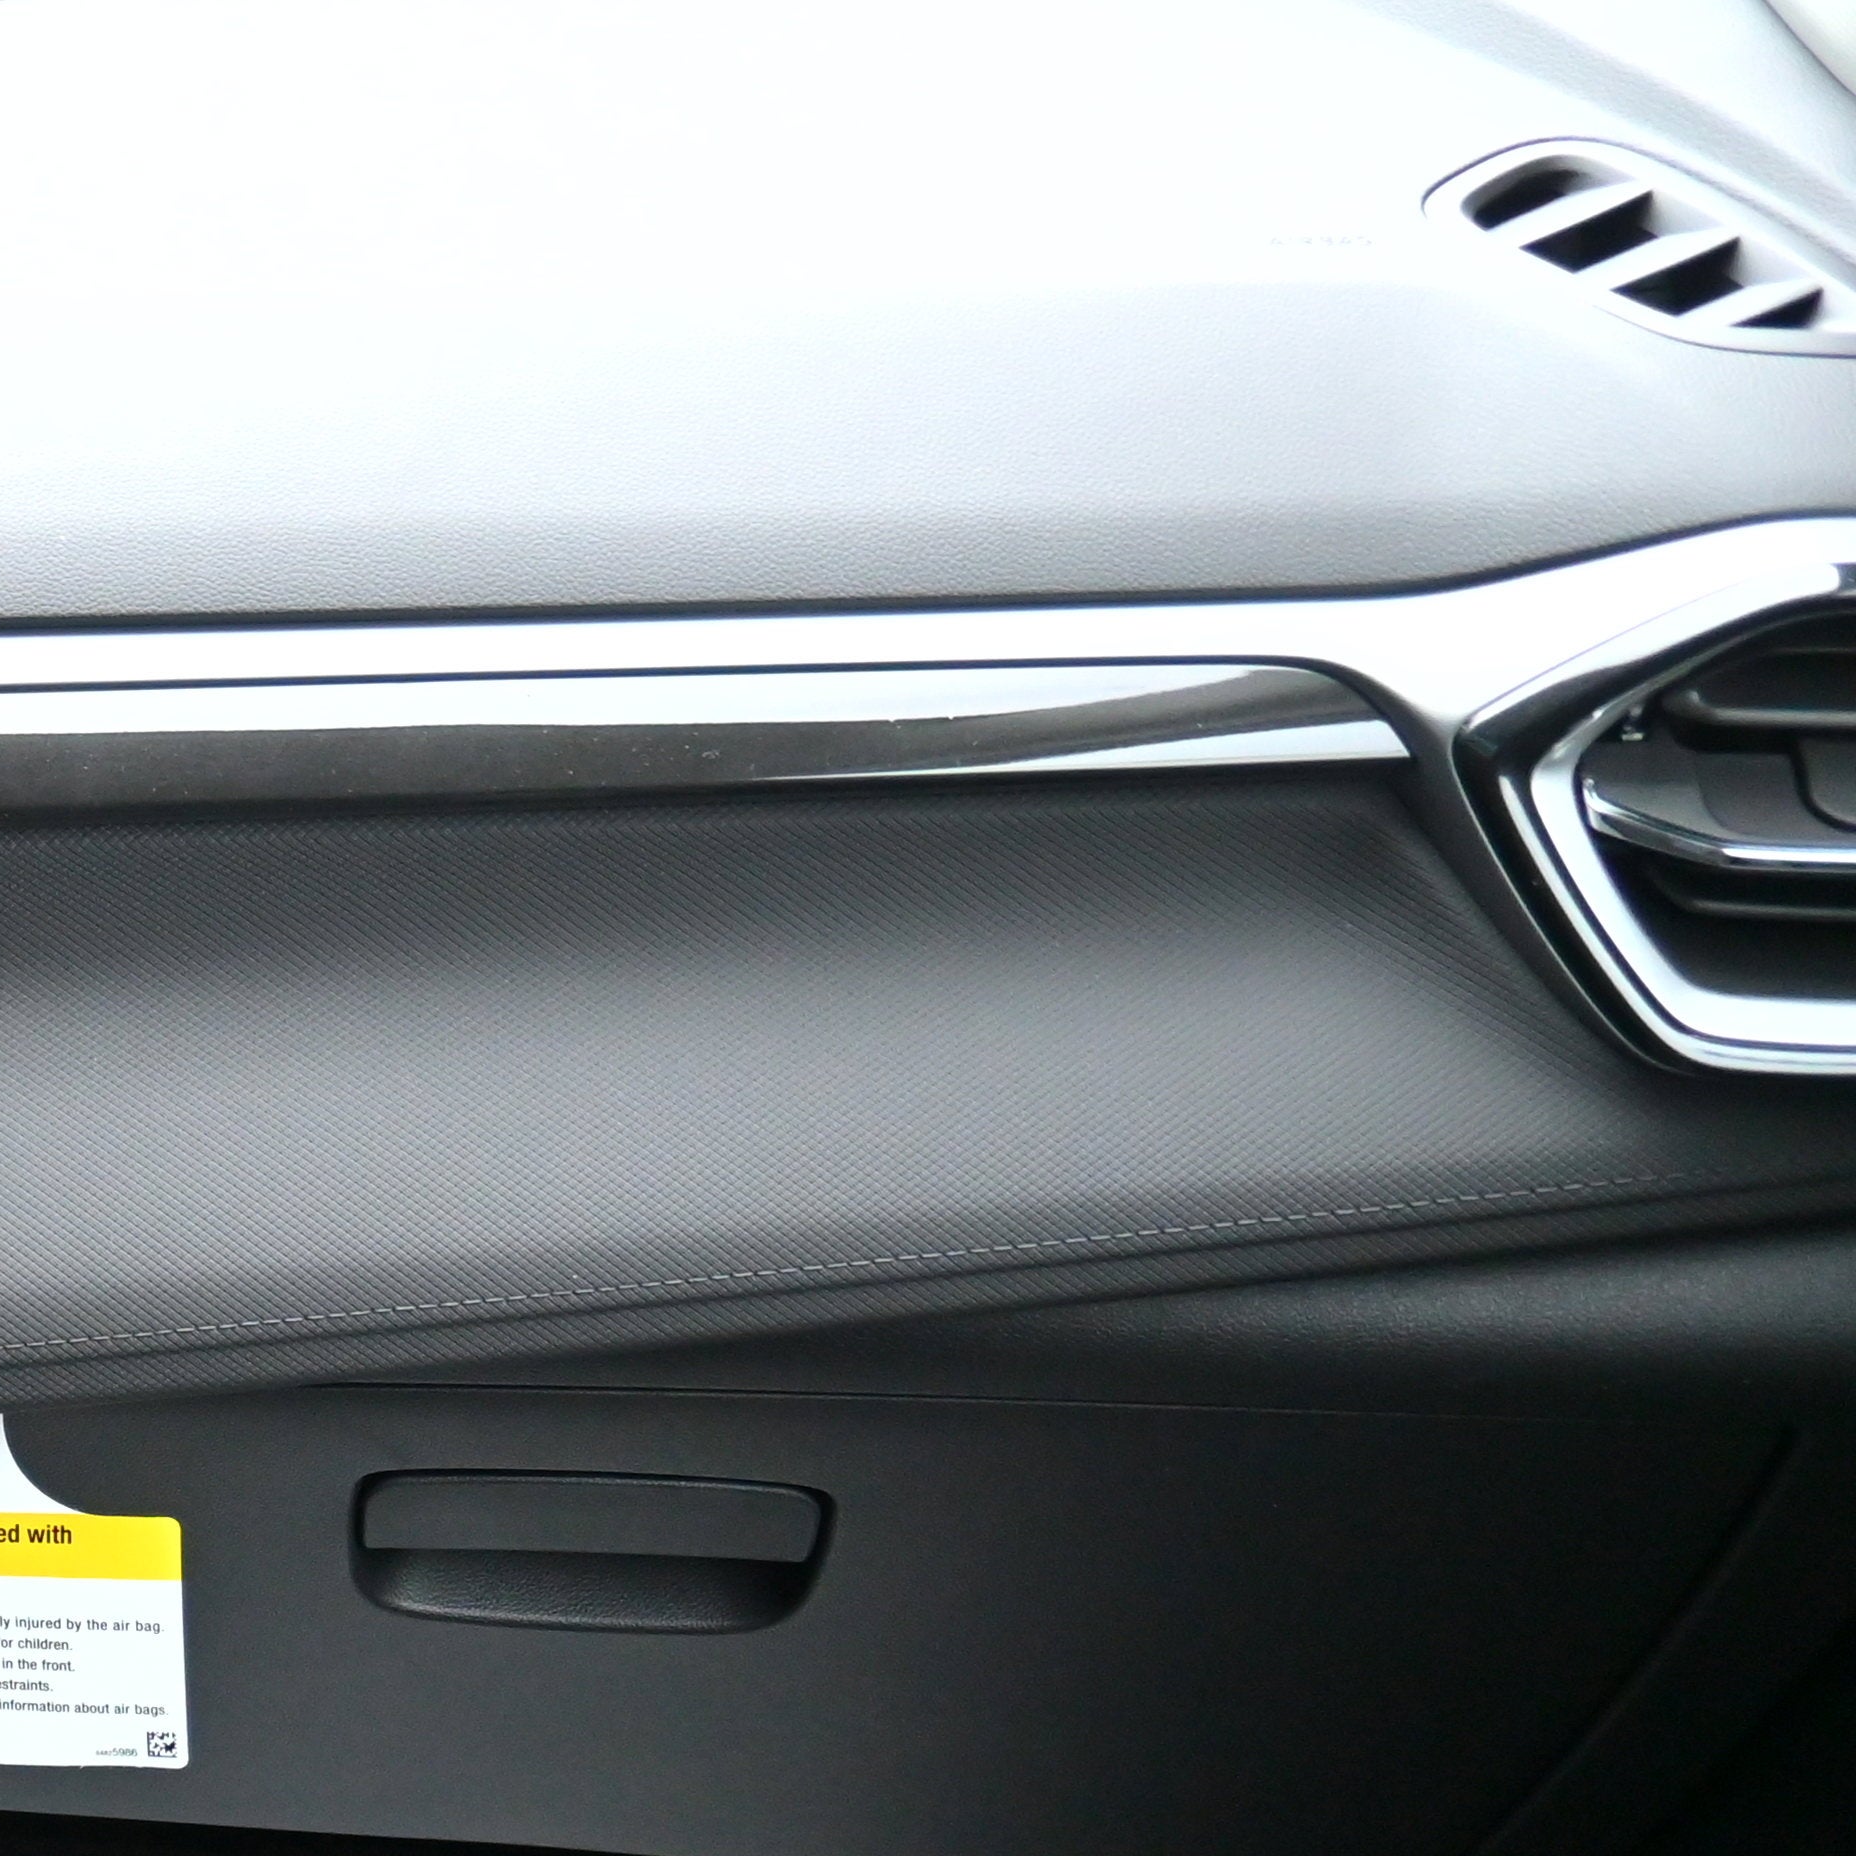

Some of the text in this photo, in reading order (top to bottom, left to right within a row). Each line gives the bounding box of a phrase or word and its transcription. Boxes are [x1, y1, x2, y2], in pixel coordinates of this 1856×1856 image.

[28, 1524, 72, 1544] with
[15, 1616, 61, 1630] injured
[66, 1618, 82, 1632] by
[87, 1619, 108, 1631] the
[113, 1620, 130, 1631] air
[135, 1620, 164, 1634] bag.
[18, 1638, 73, 1650] children.
[2, 1657, 13, 1669] in
[18, 1659, 38, 1670] the
[42, 1660, 75, 1672] front.
[0, 1700, 70, 1713] information
[74, 1704, 110, 1714] about
[114, 1704, 130, 1715] air
[135, 1704, 169, 1718] bags.
